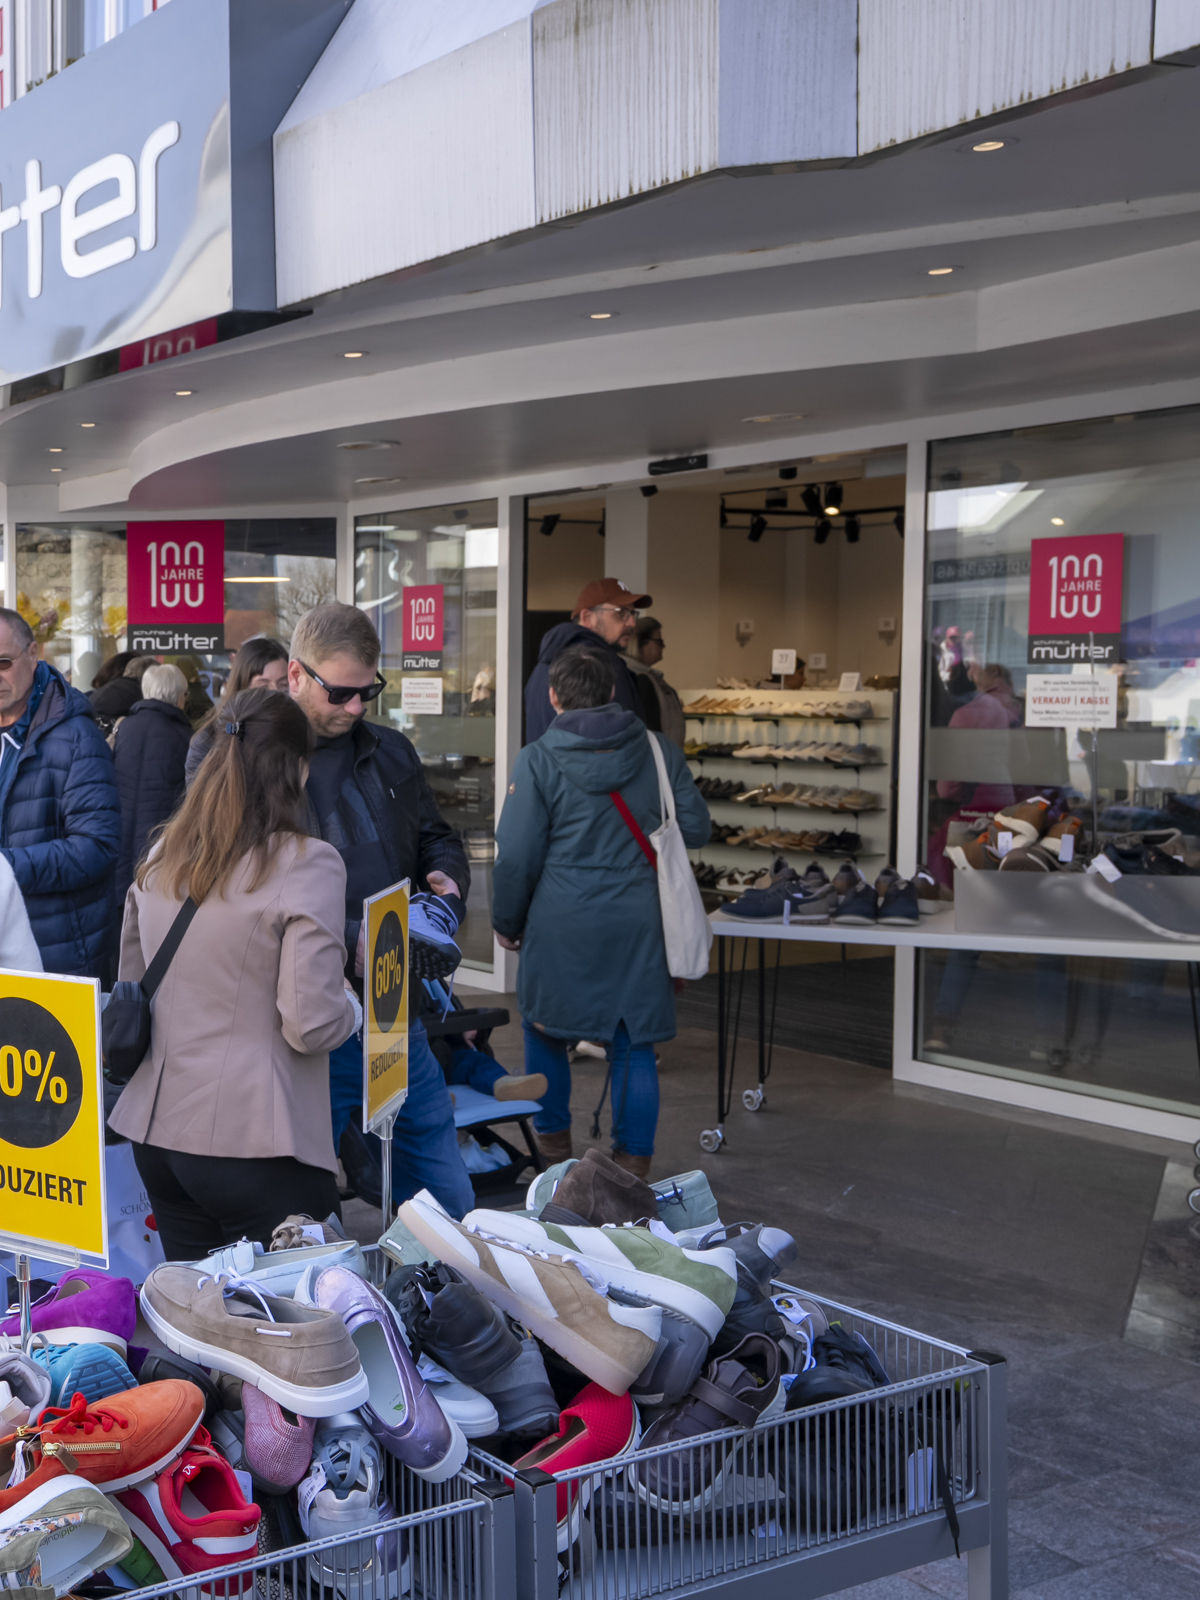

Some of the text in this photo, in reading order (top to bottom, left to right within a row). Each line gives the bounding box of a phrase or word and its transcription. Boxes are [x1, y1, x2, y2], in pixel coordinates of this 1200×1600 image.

[146, 540, 204, 608] 100
[160, 568, 204, 581] JAHRE
[1048, 553, 1103, 619] 100
[1060, 579, 1102, 593] JAHRE
[410, 597, 436, 641] 100
[132, 633, 219, 650] mutter
[1032, 643, 1114, 659] mutter
[403, 657, 441, 668] mutter
[1032, 696, 1110, 705] VERKAUF KASSE
[375, 945, 401, 999] 60%
[370, 1036, 405, 1084] REDUZIERT
